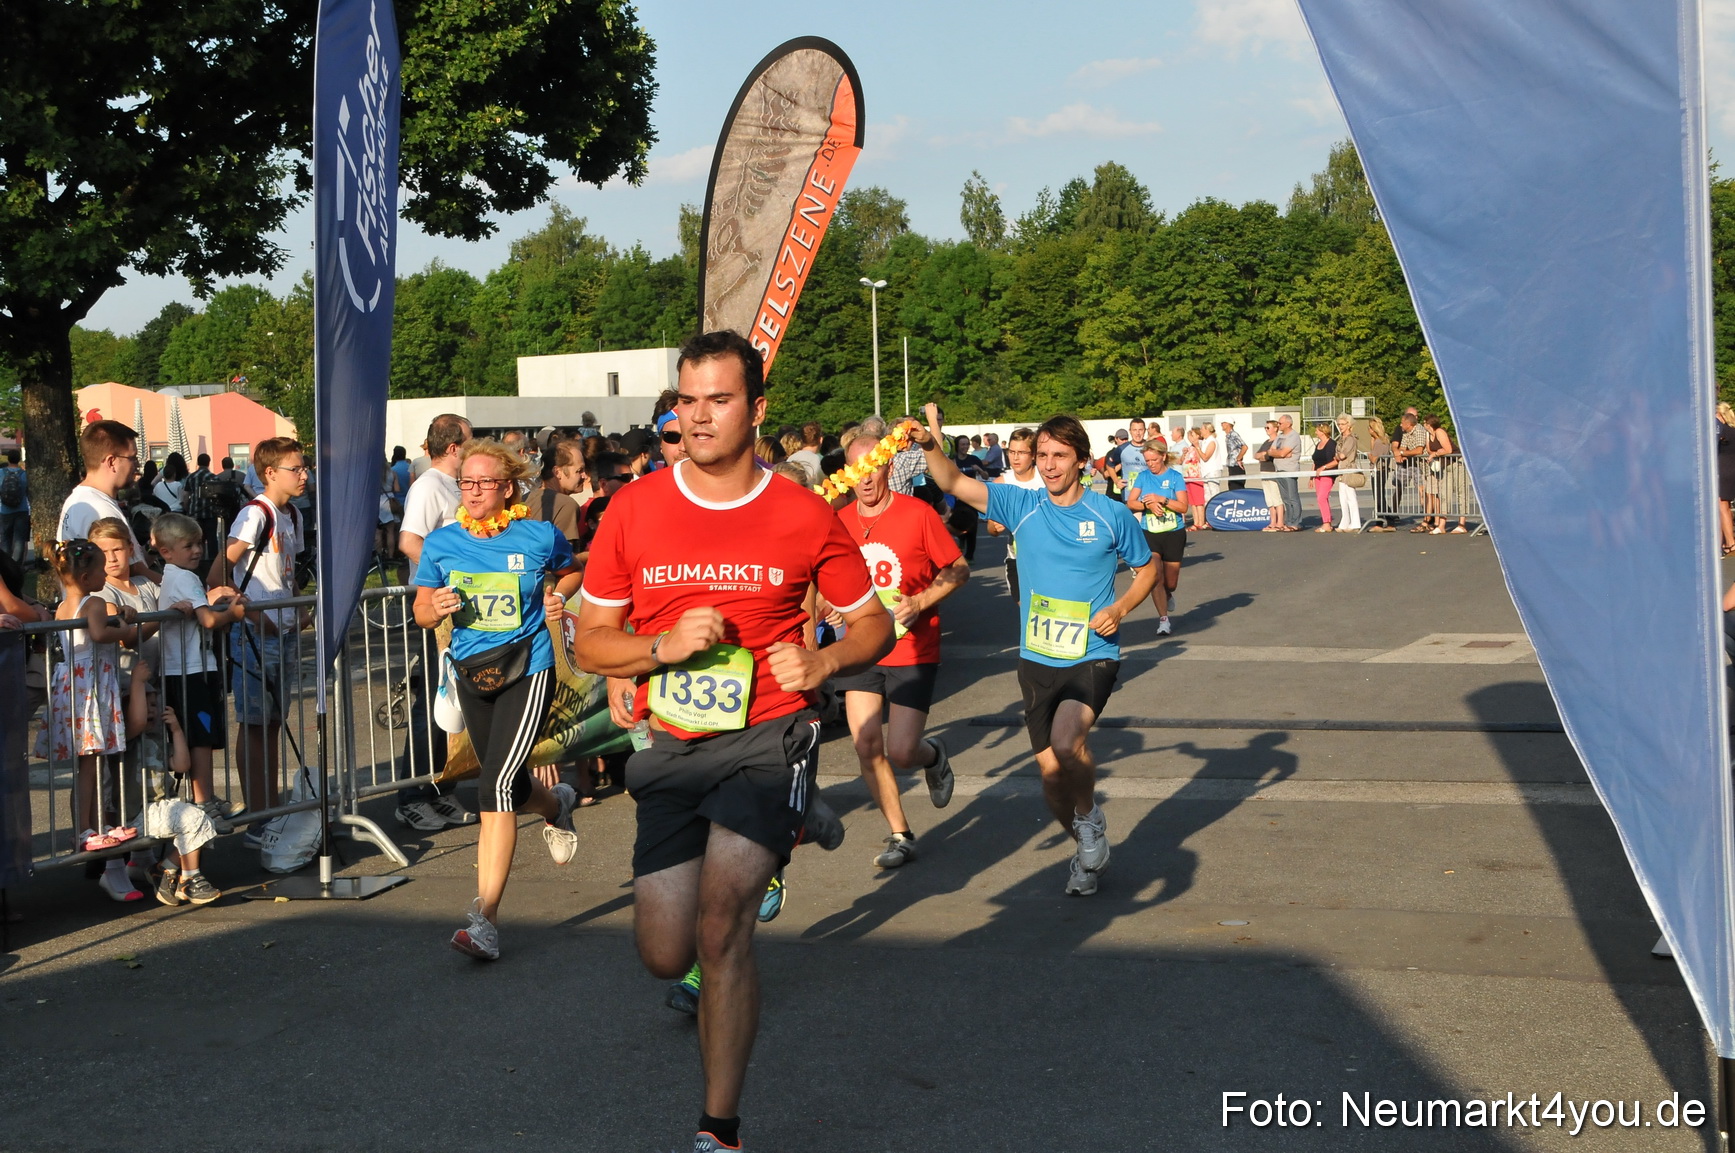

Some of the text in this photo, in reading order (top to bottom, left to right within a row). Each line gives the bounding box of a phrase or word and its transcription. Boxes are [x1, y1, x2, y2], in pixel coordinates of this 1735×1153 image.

[356, 0, 381, 266] Fischer
[378, 56, 389, 266] AUTOMOBILE
[642, 563, 764, 585] NEUMARKT
[708, 584, 762, 593] STARKE STADT
[1030, 614, 1086, 645] 1177
[472, 667, 502, 683] CAMEL
[659, 667, 743, 714] 1333
[693, 711, 707, 719] Vogt
